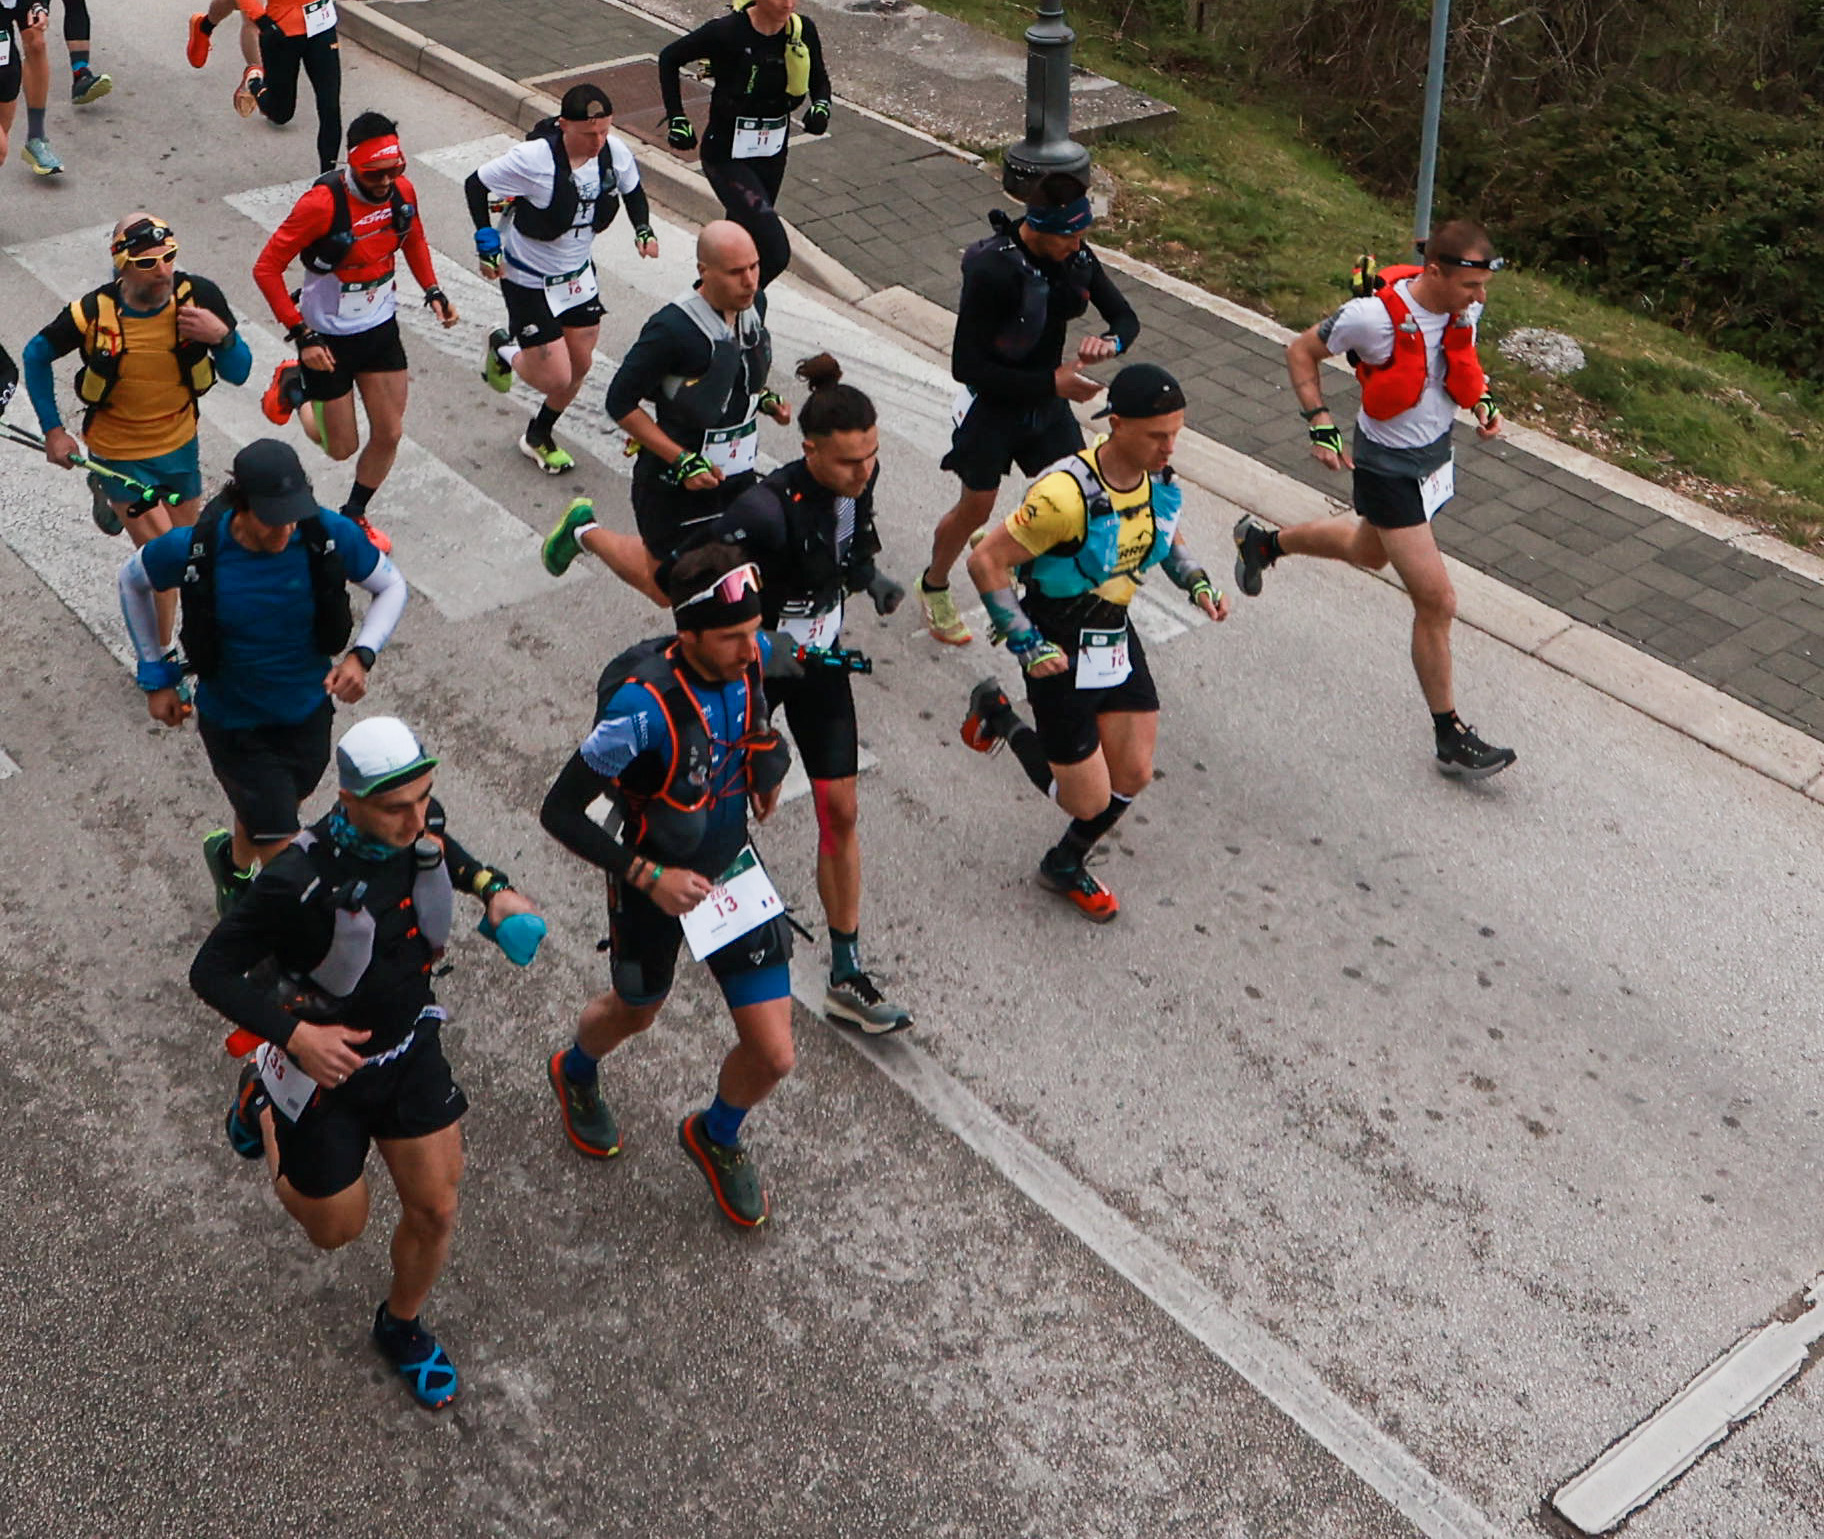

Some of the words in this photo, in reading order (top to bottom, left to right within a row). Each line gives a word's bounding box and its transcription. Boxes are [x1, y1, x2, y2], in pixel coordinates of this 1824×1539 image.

[757, 137, 768, 145] 11
[569, 285, 582, 295] 16
[367, 295, 375, 304] 9
[729, 448, 737, 459] 4
[809, 625, 823, 639] 21
[1112, 654, 1125, 668] 10
[711, 887, 728, 902] RED
[714, 895, 738, 918] 13
